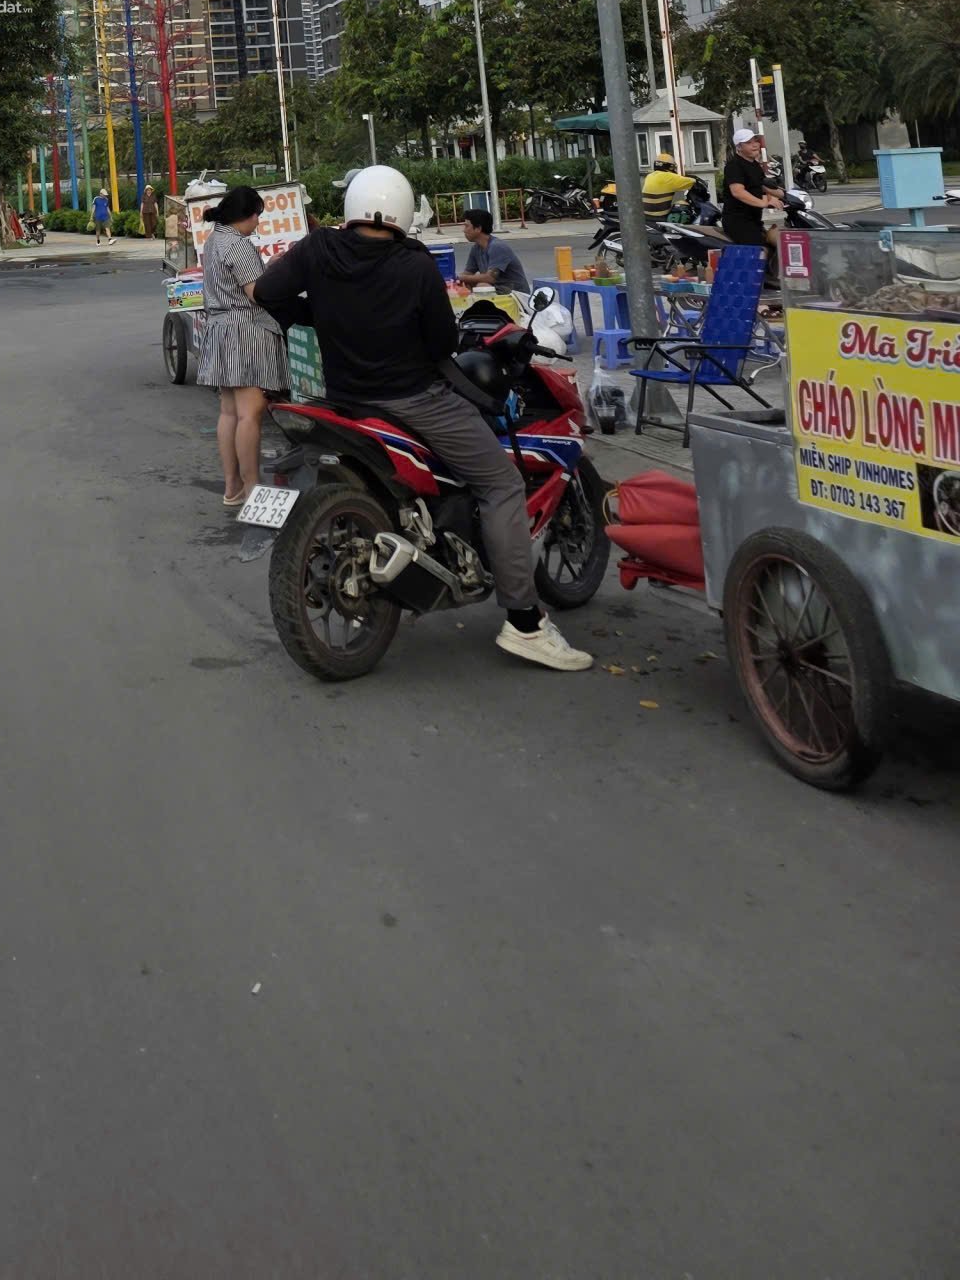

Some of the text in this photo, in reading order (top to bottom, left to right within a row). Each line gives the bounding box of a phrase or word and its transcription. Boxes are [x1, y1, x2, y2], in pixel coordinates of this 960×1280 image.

[263, 192, 297, 214] GỌT
[840, 321, 899, 359] Mã
[798, 370, 856, 440] CHÁO
[862, 376, 926, 455] LÒNG
[827, 454, 852, 476] SHIP
[854, 460, 915, 491] VINHOMES
[240, 505, 287, 525] 932.35
[254, 488, 290, 506] 60-F3
[810, 479, 906, 520] ĐT: 0703 143 367
